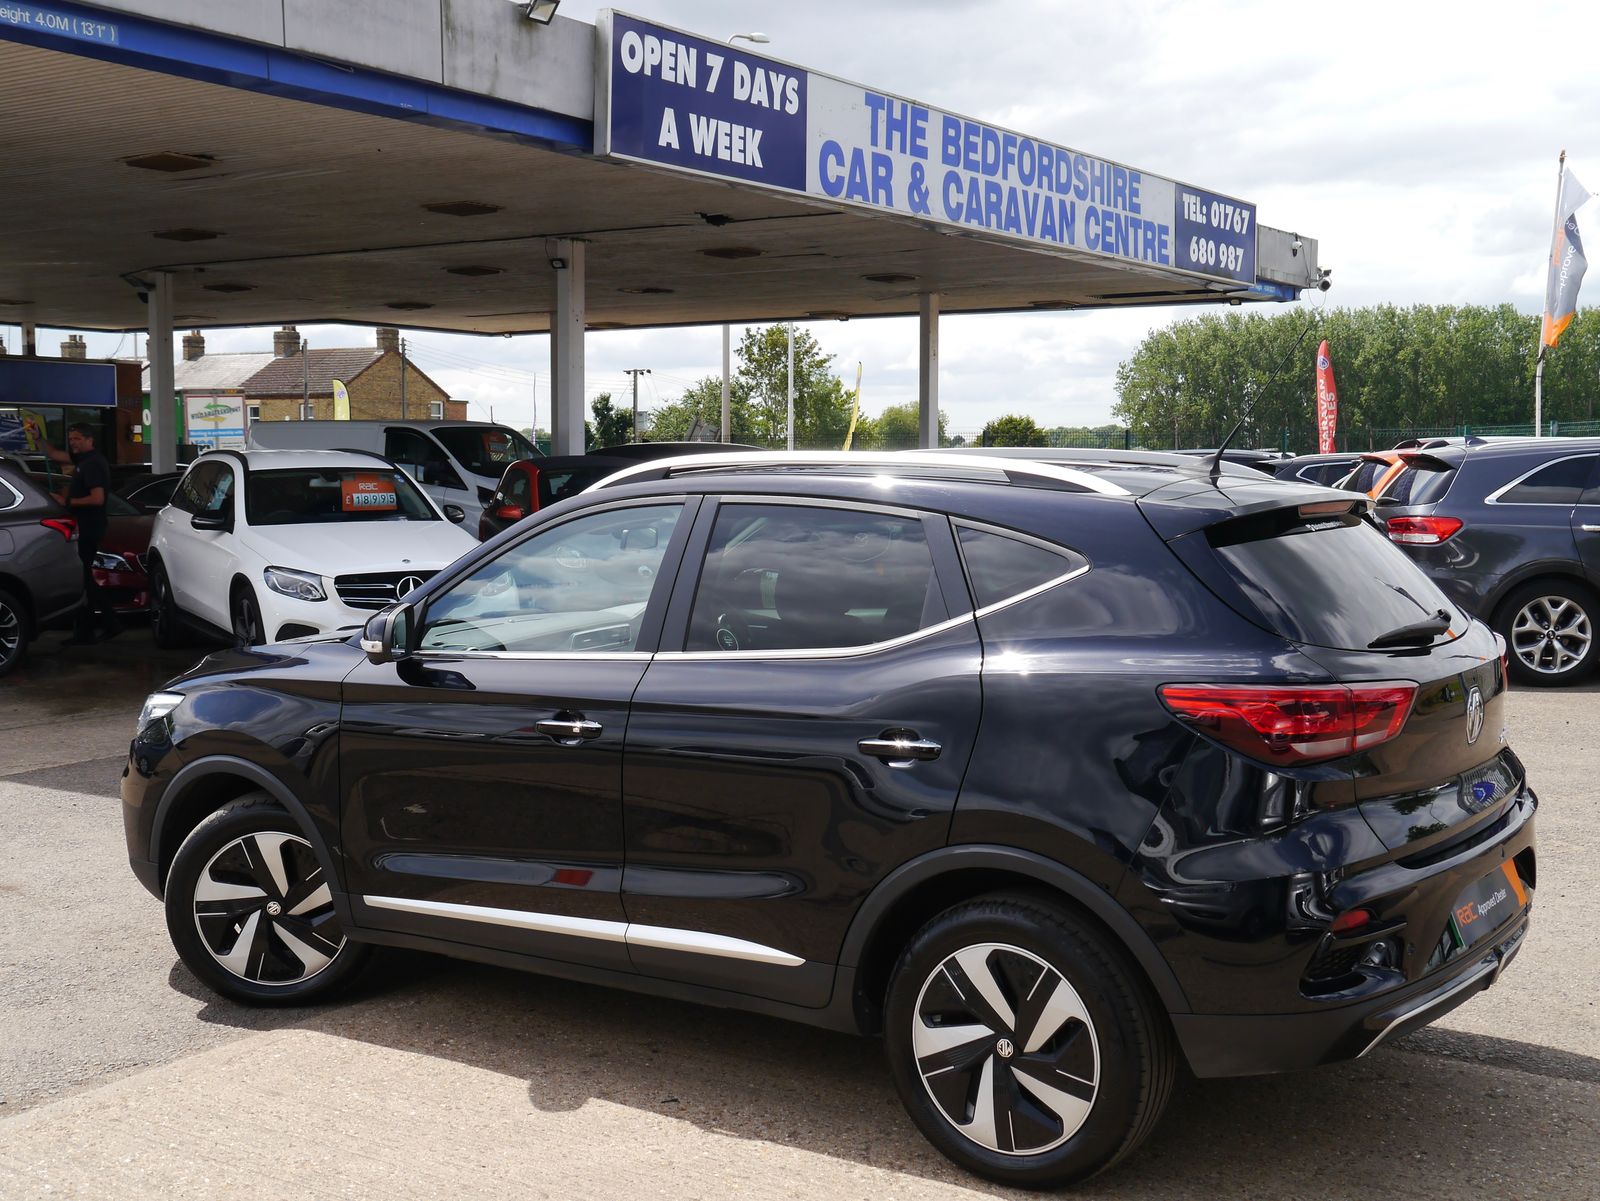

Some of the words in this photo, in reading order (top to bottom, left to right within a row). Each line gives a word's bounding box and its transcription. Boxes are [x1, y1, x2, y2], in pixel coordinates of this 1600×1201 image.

[0, 7, 31, 24] eight
[620, 30, 697, 88] OPEN
[706, 52, 724, 93] 7
[733, 60, 799, 115] DAYS
[658, 107, 680, 150] A
[689, 113, 763, 168] WEEK
[865, 92, 929, 160] THE
[942, 115, 1142, 215] BEDFORDSHIRE
[819, 140, 894, 208] CAR
[907, 162, 931, 215] &
[942, 170, 1076, 246] CARAVAN
[1084, 205, 1170, 265] CENTRE
[1182, 192, 1207, 225] TEL:
[1210, 201, 1250, 235] 01767
[1189, 236, 1216, 266] 680
[1219, 243, 1244, 272] 987
